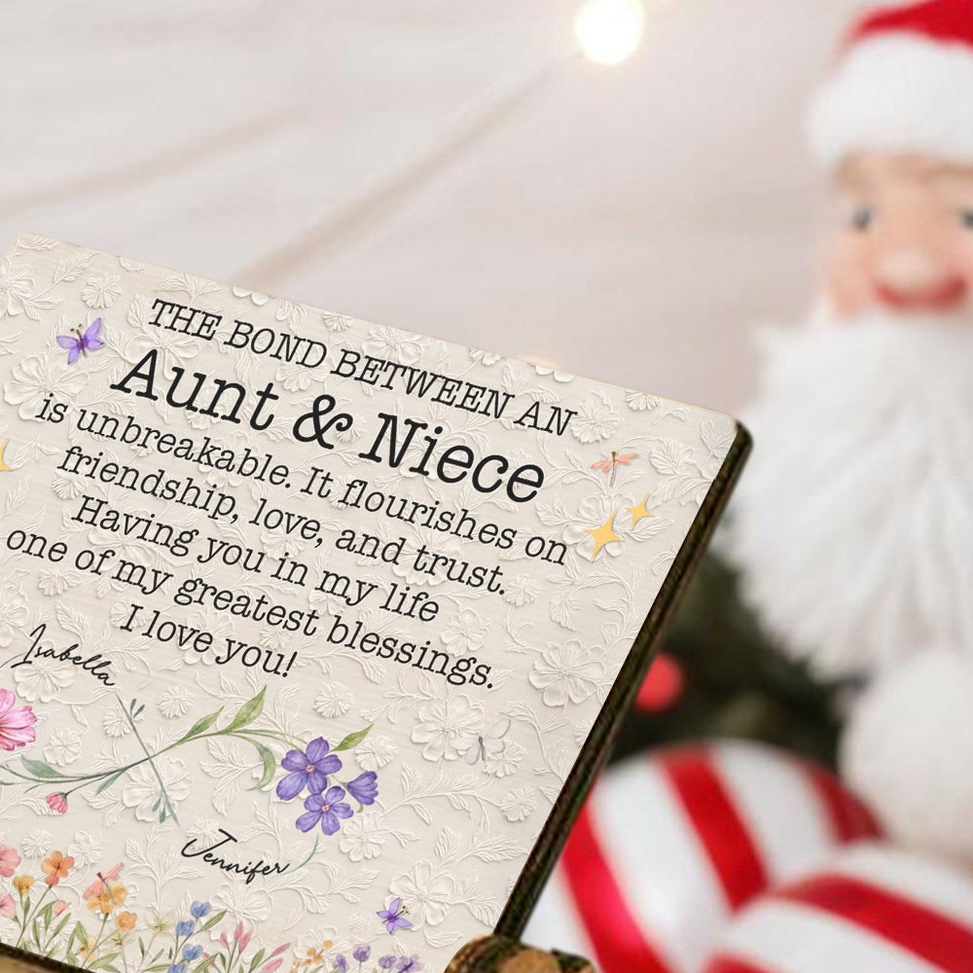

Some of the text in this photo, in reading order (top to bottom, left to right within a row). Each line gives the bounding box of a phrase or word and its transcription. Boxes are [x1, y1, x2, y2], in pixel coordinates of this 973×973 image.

[110, 349, 544, 502] Aunt & Niece
[149, 299, 577, 435] THE BOND BETWEEN AN
[35, 393, 566, 565] is unbreakable. It flourishes on
[57, 446, 505, 594] friendship, love, and trust.
[7, 530, 67, 562] one
[76, 550, 115, 575] of
[112, 560, 173, 594] my
[174, 578, 320, 636] greatest
[327, 615, 493, 688] blessings.
[71, 495, 439, 621] Having you in my life
[11, 624, 115, 686] Isabella
[120, 604, 297, 677] I love you!
[181, 829, 290, 884] Jennifer
